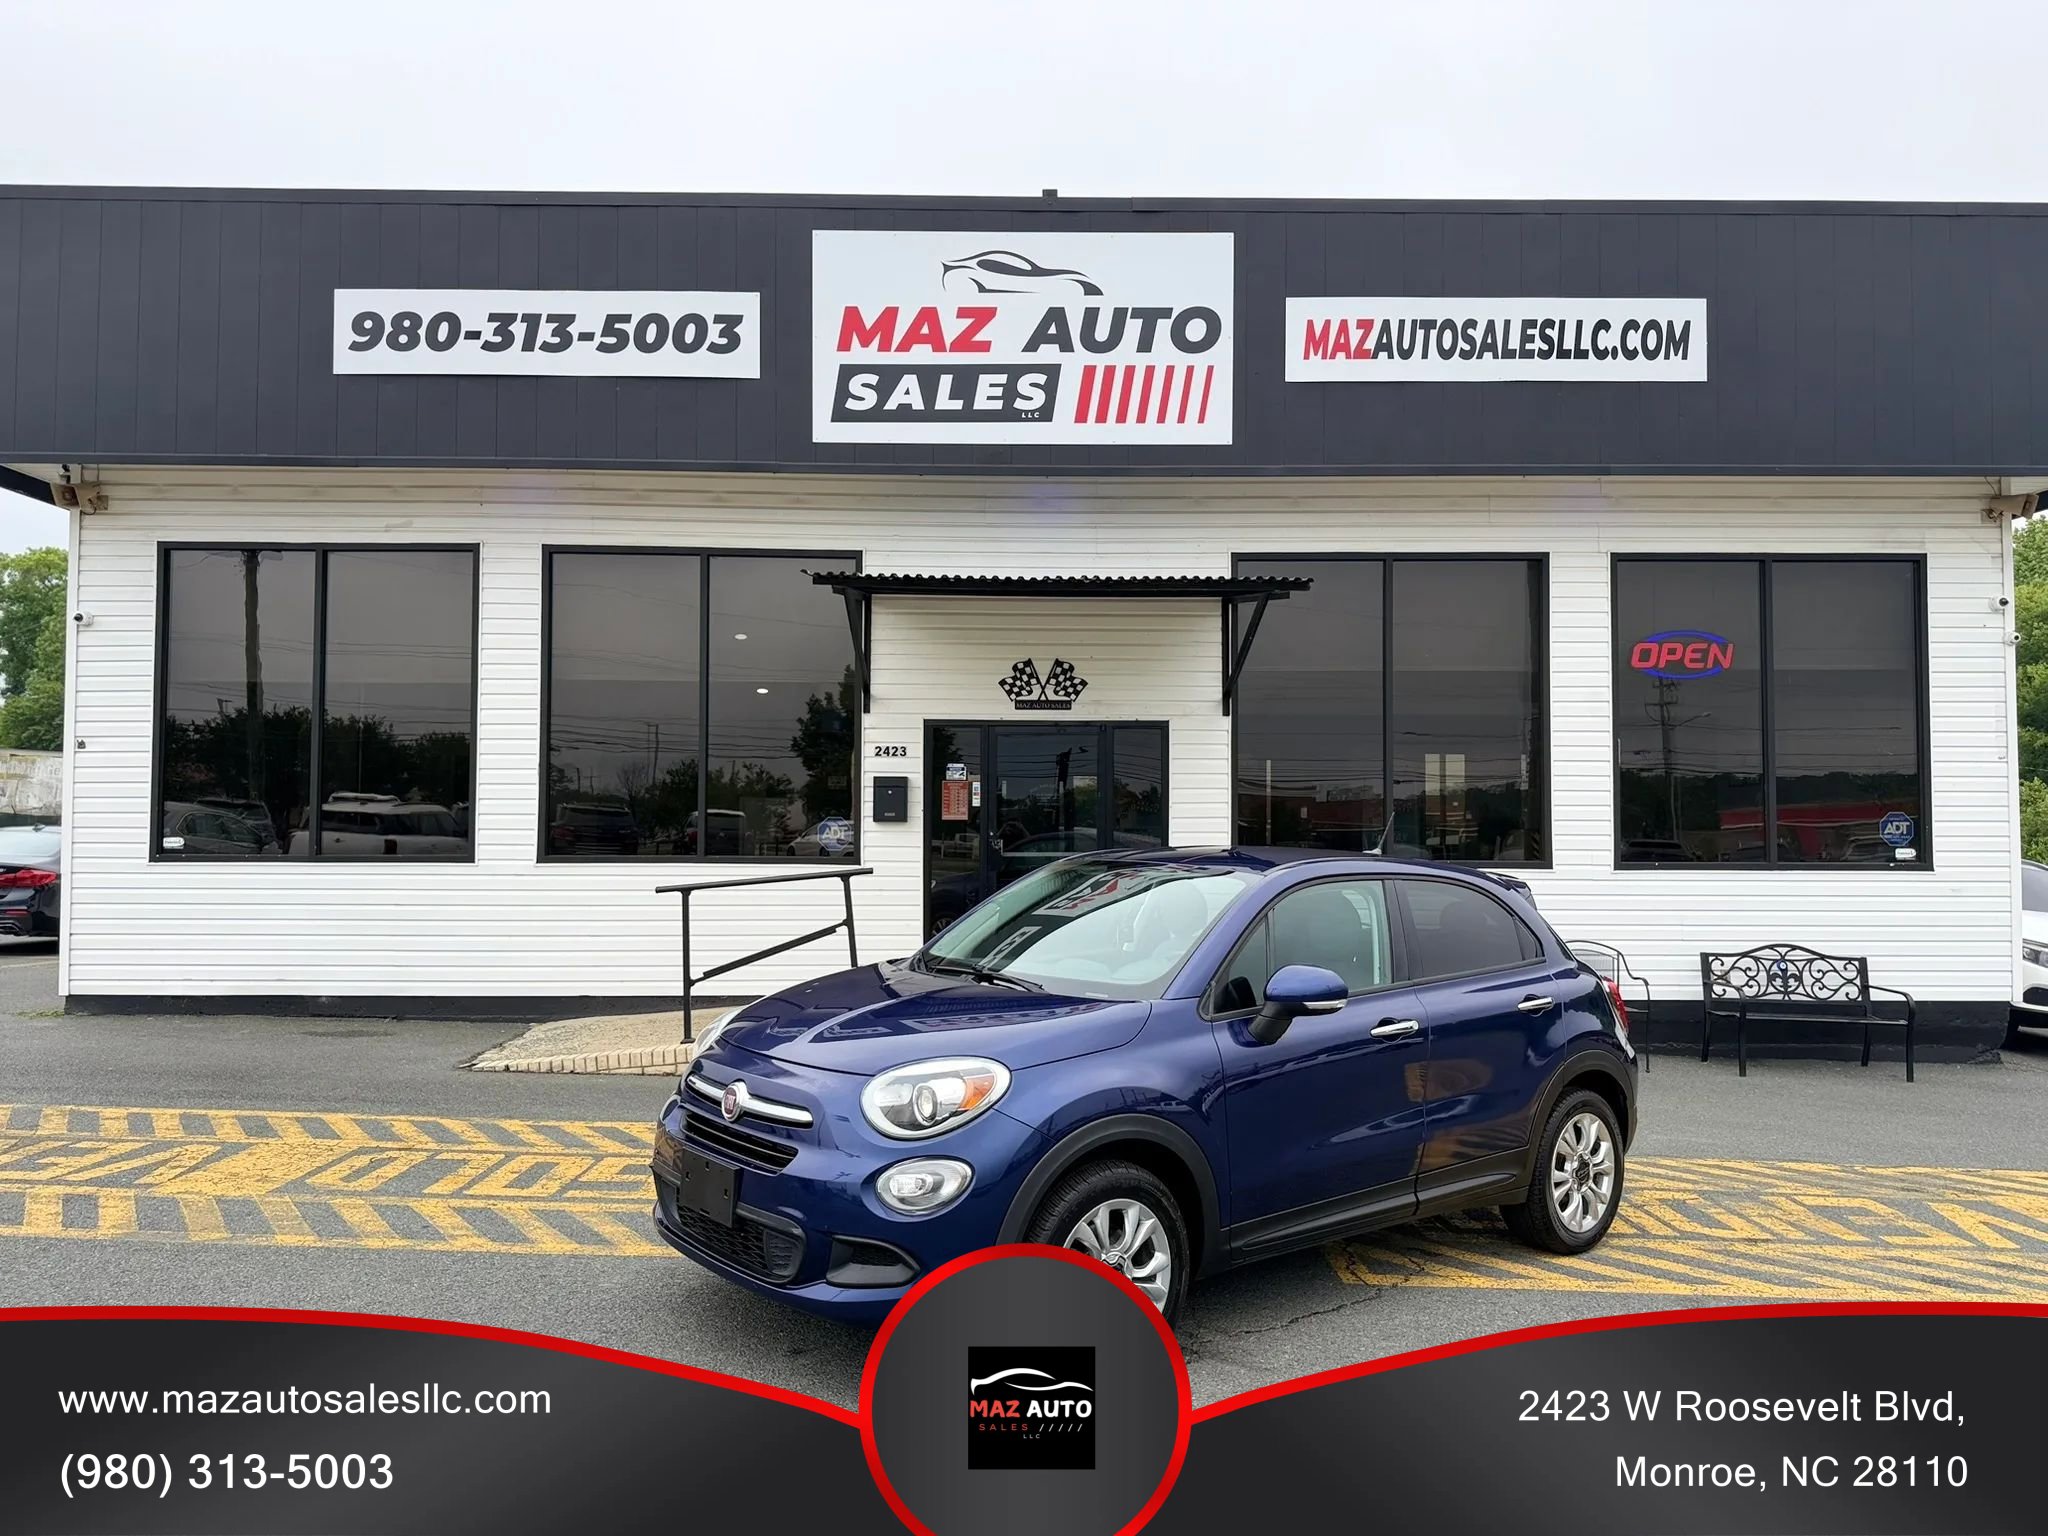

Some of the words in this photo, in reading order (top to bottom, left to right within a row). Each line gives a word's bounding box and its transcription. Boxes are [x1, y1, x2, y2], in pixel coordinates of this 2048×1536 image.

[347, 310, 744, 355] 980-313-5003
[836, 305, 998, 353] MAZ
[1021, 305, 1223, 354] AUTO
[1302, 317, 1691, 361] MAZAUTOSALESLLC.COM
[844, 373, 1049, 412] SALES
[1021, 411, 1041, 419] LLC
[1630, 641, 1734, 670] OPEN
[874, 746, 907, 757] 2423
[822, 827, 848, 840] ADT
[1884, 822, 1910, 834] ADT
